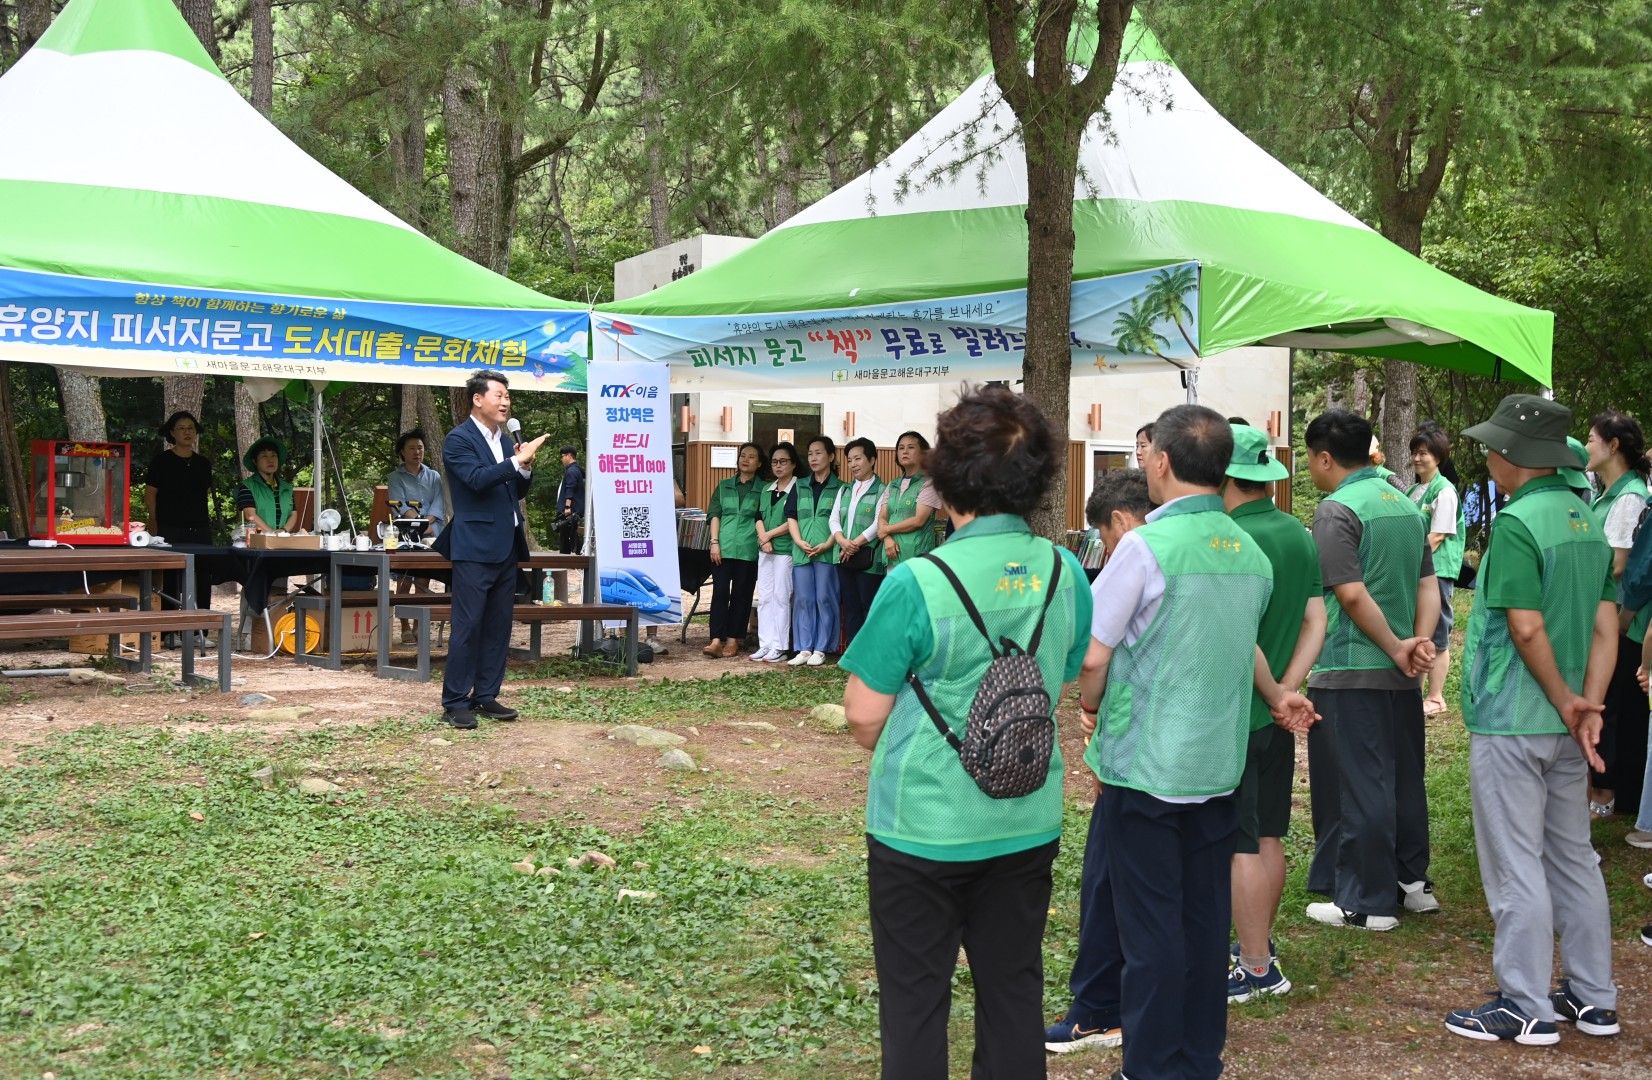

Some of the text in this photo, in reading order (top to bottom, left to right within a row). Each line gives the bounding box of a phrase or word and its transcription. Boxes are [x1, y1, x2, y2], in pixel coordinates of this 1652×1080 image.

[135, 292, 347, 320] 항상 책이 함께하는 향기로운 삶
[765, 320, 786, 332] 도시
[912, 307, 944, 322] 휴가를
[0, 304, 528, 367] 휴양지 피서지문고 도서대출·문화체험
[686, 346, 757, 368] 피서지
[763, 338, 807, 367] 문고
[880, 328, 947, 360] 무료로
[206, 360, 326, 376] 새마을문고해운대구지부
[854, 365, 949, 380] 새마을문고해운대구지부
[600, 383, 658, 399] KTX-이음
[605, 407, 654, 422] 정차역은
[612, 433, 650, 448] 반드시
[598, 453, 666, 473] 해운대여야
[614, 479, 653, 494] 합니다!
[1003, 564, 1027, 576] SMU
[995, 575, 1043, 596] 새마을
